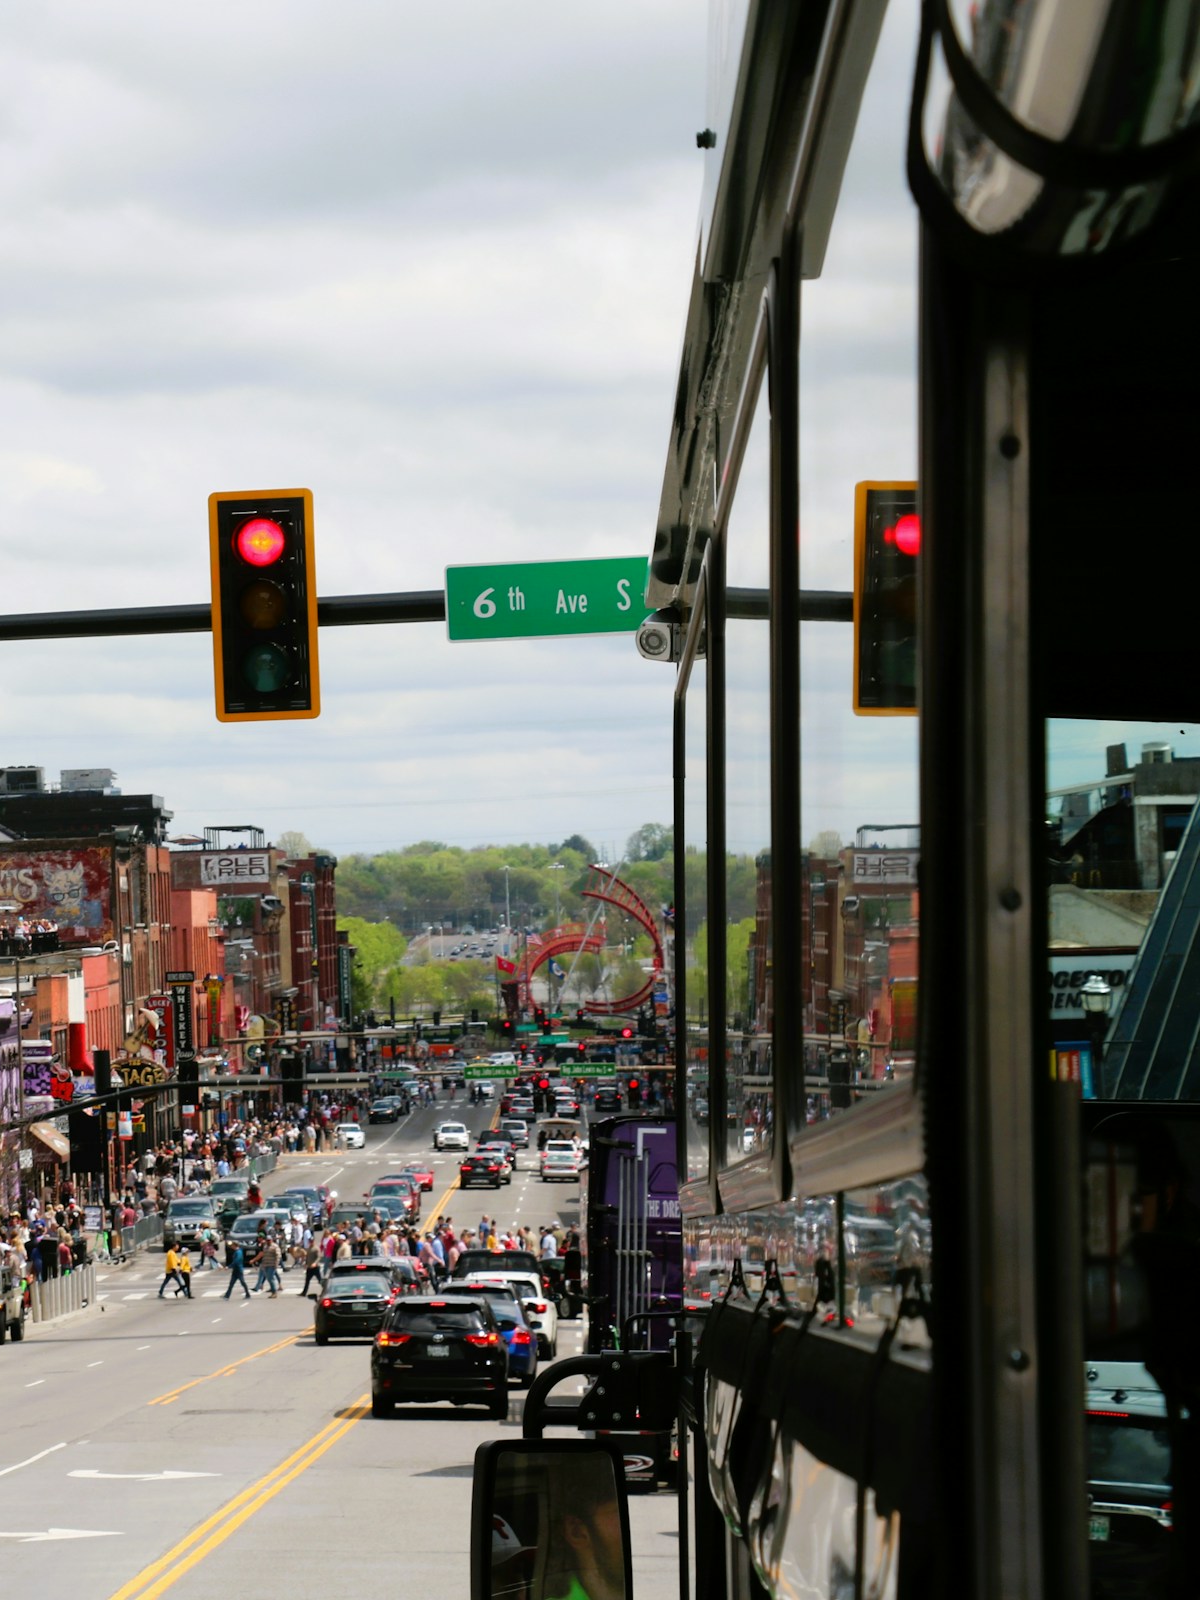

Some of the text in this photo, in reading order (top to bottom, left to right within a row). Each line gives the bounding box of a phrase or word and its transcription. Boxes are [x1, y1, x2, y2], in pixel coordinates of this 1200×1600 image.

[556, 589, 588, 614] Ave
[617, 579, 631, 611] S
[218, 857, 265, 867] OLE
[218, 867, 266, 876] RED
[176, 986, 187, 1048] WHISKEY
[662, 1200, 681, 1218] DRE
